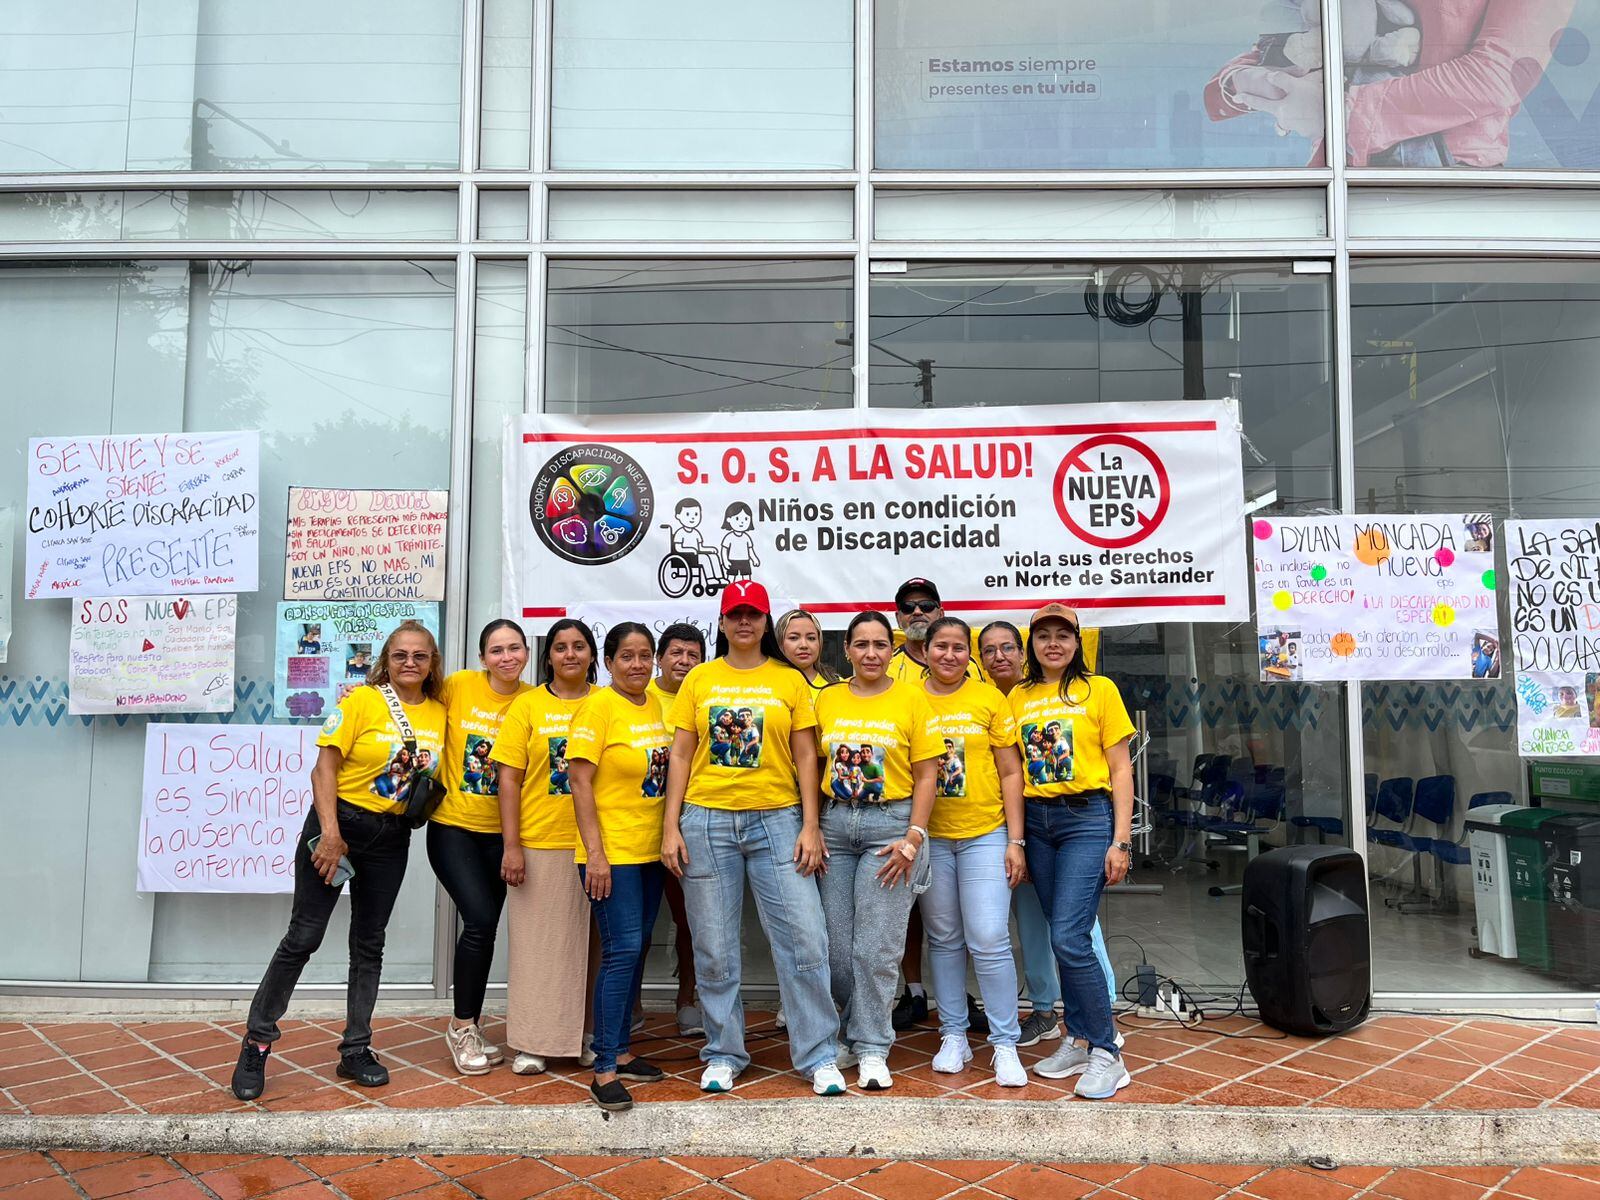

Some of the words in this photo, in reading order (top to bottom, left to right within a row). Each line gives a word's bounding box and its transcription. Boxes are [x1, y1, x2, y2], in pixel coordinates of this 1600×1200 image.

[929, 58, 1014, 72] Estamos
[1019, 57, 1096, 74] siempre
[929, 83, 1008, 98] presentes
[1012, 84, 1033, 94] en
[1037, 82, 1056, 94] tu
[1060, 80, 1096, 94] vida
[36, 442, 81, 476] SE
[88, 437, 146, 473] VIVE
[154, 435, 169, 468] Y
[175, 439, 205, 465] SE
[676, 448, 709, 485] S.
[721, 447, 756, 484] O.
[768, 446, 799, 483] S.
[811, 446, 837, 482] A
[849, 443, 894, 480] LA
[904, 441, 1033, 480] SALUD!
[1100, 452, 1123, 471] La
[106, 470, 168, 499] SIENTE
[534, 475, 551, 520] COHORTE
[549, 448, 624, 473] DISCAPACIDAD
[625, 463, 647, 494] NUEVA
[639, 498, 650, 518] EPS
[1068, 474, 1156, 501] NUEVA
[29, 497, 127, 534] COHORTE
[133, 492, 255, 527] DISCAPACIDAD
[369, 490, 430, 511] David
[758, 497, 834, 522] Niños
[843, 501, 875, 520] en
[884, 493, 1016, 520] condición
[1089, 503, 1135, 528] EPS
[372, 527, 384, 538] SE
[775, 527, 808, 552] de
[817, 523, 1000, 555] Discapacidad
[1280, 525, 1340, 553] DYLAN
[1354, 522, 1457, 551] MONCADA
[1518, 527, 1557, 556] LA
[102, 529, 233, 587] PRESENTE
[361, 545, 374, 557] NO
[1004, 551, 1051, 568] viola
[1058, 553, 1093, 567] sus
[1099, 548, 1194, 566] derechos
[292, 565, 322, 580] NUEVA
[328, 559, 352, 575] EPS
[362, 560, 377, 573] NO
[984, 575, 1008, 588] en
[1015, 570, 1072, 588] Norte
[1079, 569, 1103, 586] de
[1110, 567, 1214, 585] Santander
[1337, 561, 1350, 571] no
[1377, 555, 1443, 577] nueva
[326, 577, 342, 588] ES
[345, 575, 361, 586] UN
[367, 572, 423, 586] DERECHO
[1261, 580, 1275, 589] es
[1278, 578, 1290, 589] un
[1324, 577, 1337, 587] es
[1340, 577, 1352, 587] un
[1475, 595, 1490, 608] NO
[1517, 581, 1546, 608] NO
[205, 598, 236, 620] EPS
[1551, 605, 1578, 633] UN
[162, 732, 197, 775] La
[209, 729, 303, 774] Salud
[155, 787, 191, 813] es
[144, 817, 164, 857] la
[169, 819, 285, 852] ausencia
